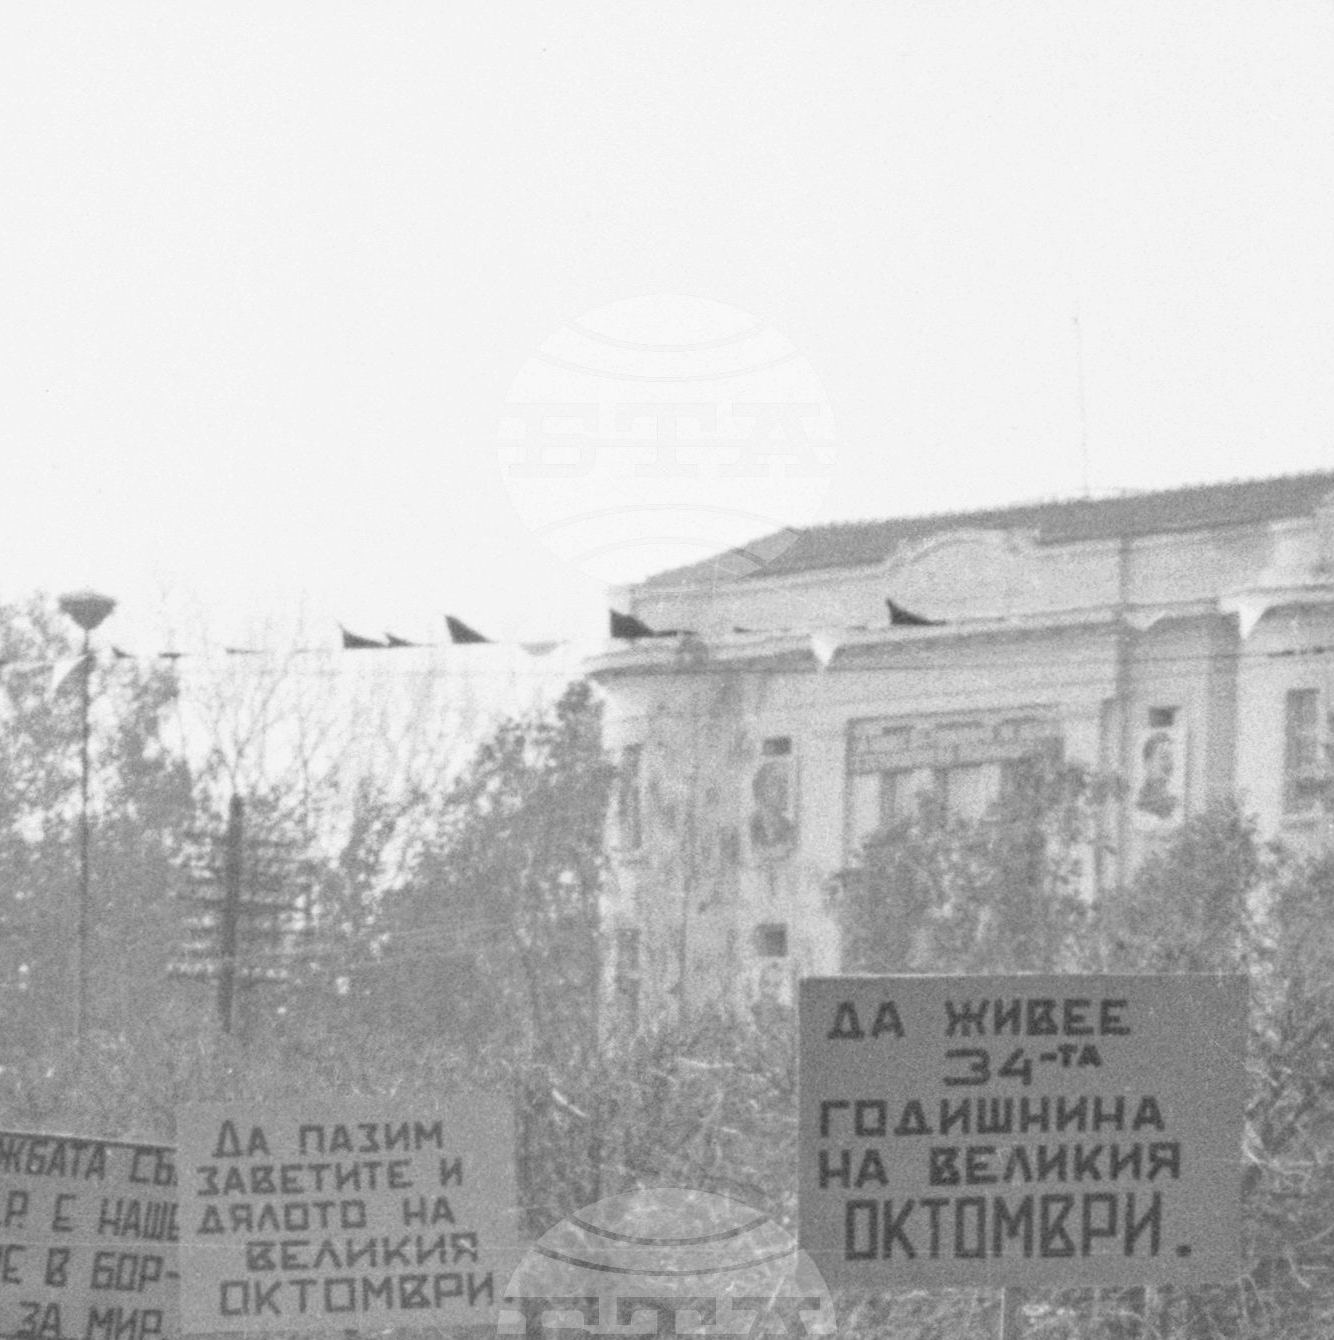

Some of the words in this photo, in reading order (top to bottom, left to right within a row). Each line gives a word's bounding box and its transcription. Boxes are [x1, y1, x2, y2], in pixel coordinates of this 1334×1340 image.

[826, 1001, 905, 1039] ДА
[945, 998, 1132, 1037] ЖИВЕЕ
[818, 1096, 1166, 1138] ГОДИШНИНА
[212, 1120, 269, 1157] ДА
[299, 1120, 444, 1154] ПАЗИМ
[130, 1147, 178, 1187] СЪ
[196, 1158, 413, 1196] ЗАВЕТИТЕ
[439, 1157, 463, 1187] И
[818, 1149, 889, 1190] НА
[929, 1141, 1182, 1187] ВЕЛИКИЯ
[52, 1194, 76, 1231] Е
[196, 1199, 366, 1235] ДЯЛОТО
[403, 1196, 456, 1227] НА
[843, 1192, 1192, 1261] ОКТОМВРИ.
[45, 1247, 70, 1287] В
[91, 1251, 180, 1293] БОР-
[246, 1232, 478, 1271] ВЕЛИКИЯ
[17, 1301, 61, 1340] ЗА
